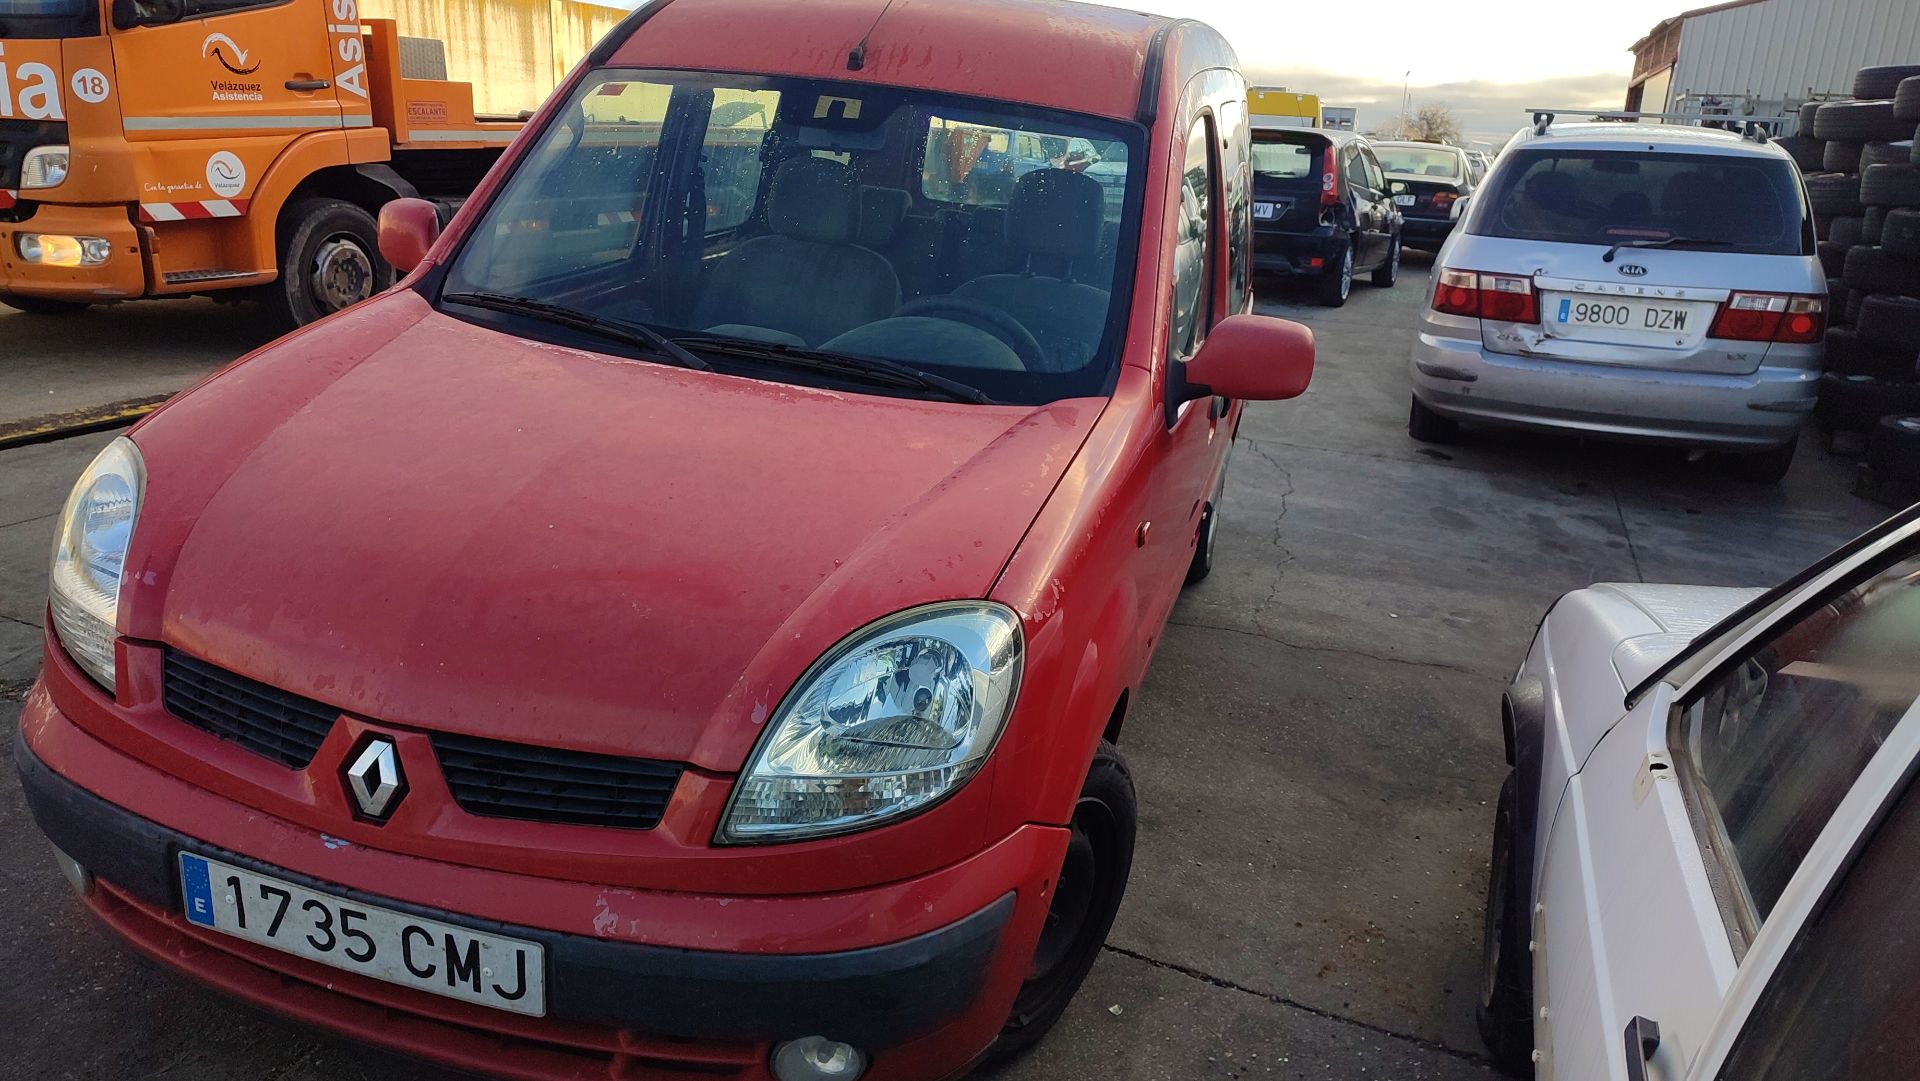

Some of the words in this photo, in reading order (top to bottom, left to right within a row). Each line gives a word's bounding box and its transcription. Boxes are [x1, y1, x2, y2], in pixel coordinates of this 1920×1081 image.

[78, 76, 104, 95] 18
[211, 81, 261, 93] Velázquez
[213, 92, 263, 101] Asistencia
[408, 107, 447, 116] ESCALANTE
[1622, 264, 1644, 275] KIA
[1575, 303, 1630, 325] 9800
[1644, 308, 1688, 331] DZW
[194, 897, 207, 914] E
[226, 875, 377, 963] 1735
[401, 925, 527, 1001] CMJ
